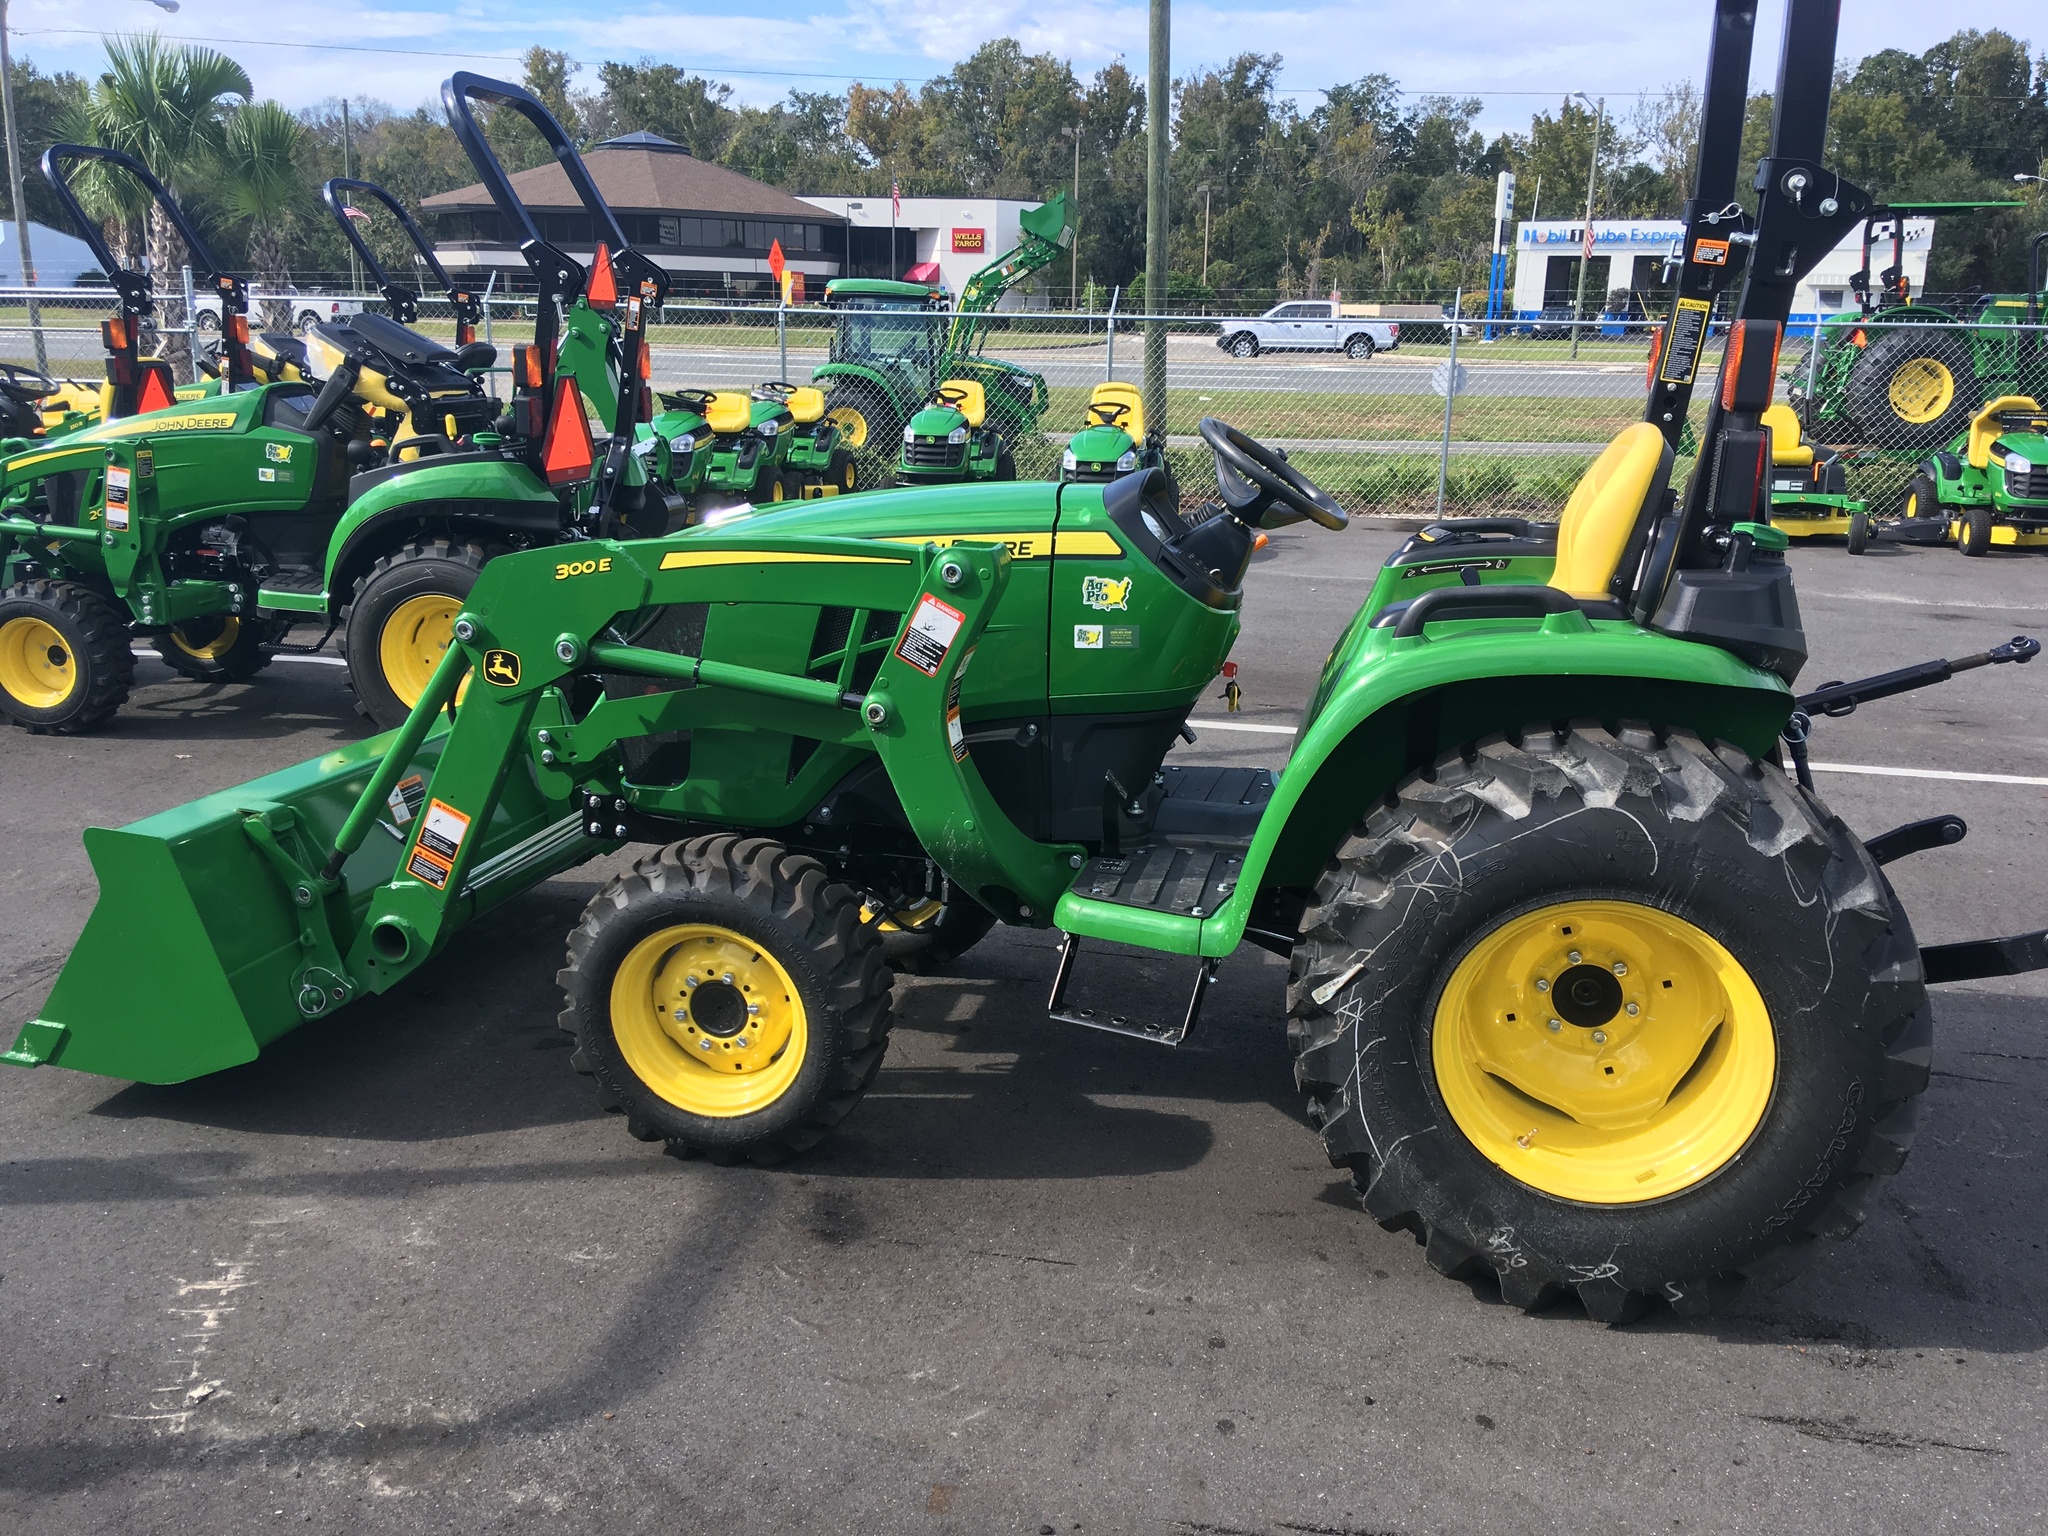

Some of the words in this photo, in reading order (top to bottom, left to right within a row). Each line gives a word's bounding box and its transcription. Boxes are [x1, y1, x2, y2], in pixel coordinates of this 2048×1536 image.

[1524, 229, 1567, 243] Mobil
[1590, 230, 1626, 243] ube
[1685, 302, 1709, 310] CAUTION
[151, 421, 184, 431] JOHN
[187, 418, 228, 428] DEERE
[554, 560, 597, 580] 300
[598, 557, 612, 572] E
[1086, 579, 1108, 592] Ag-
[1086, 591, 1109, 602] Pro
[935, 601, 961, 620] DANGER
[442, 805, 466, 821] WARNING
[424, 852, 448, 868] WARNING
